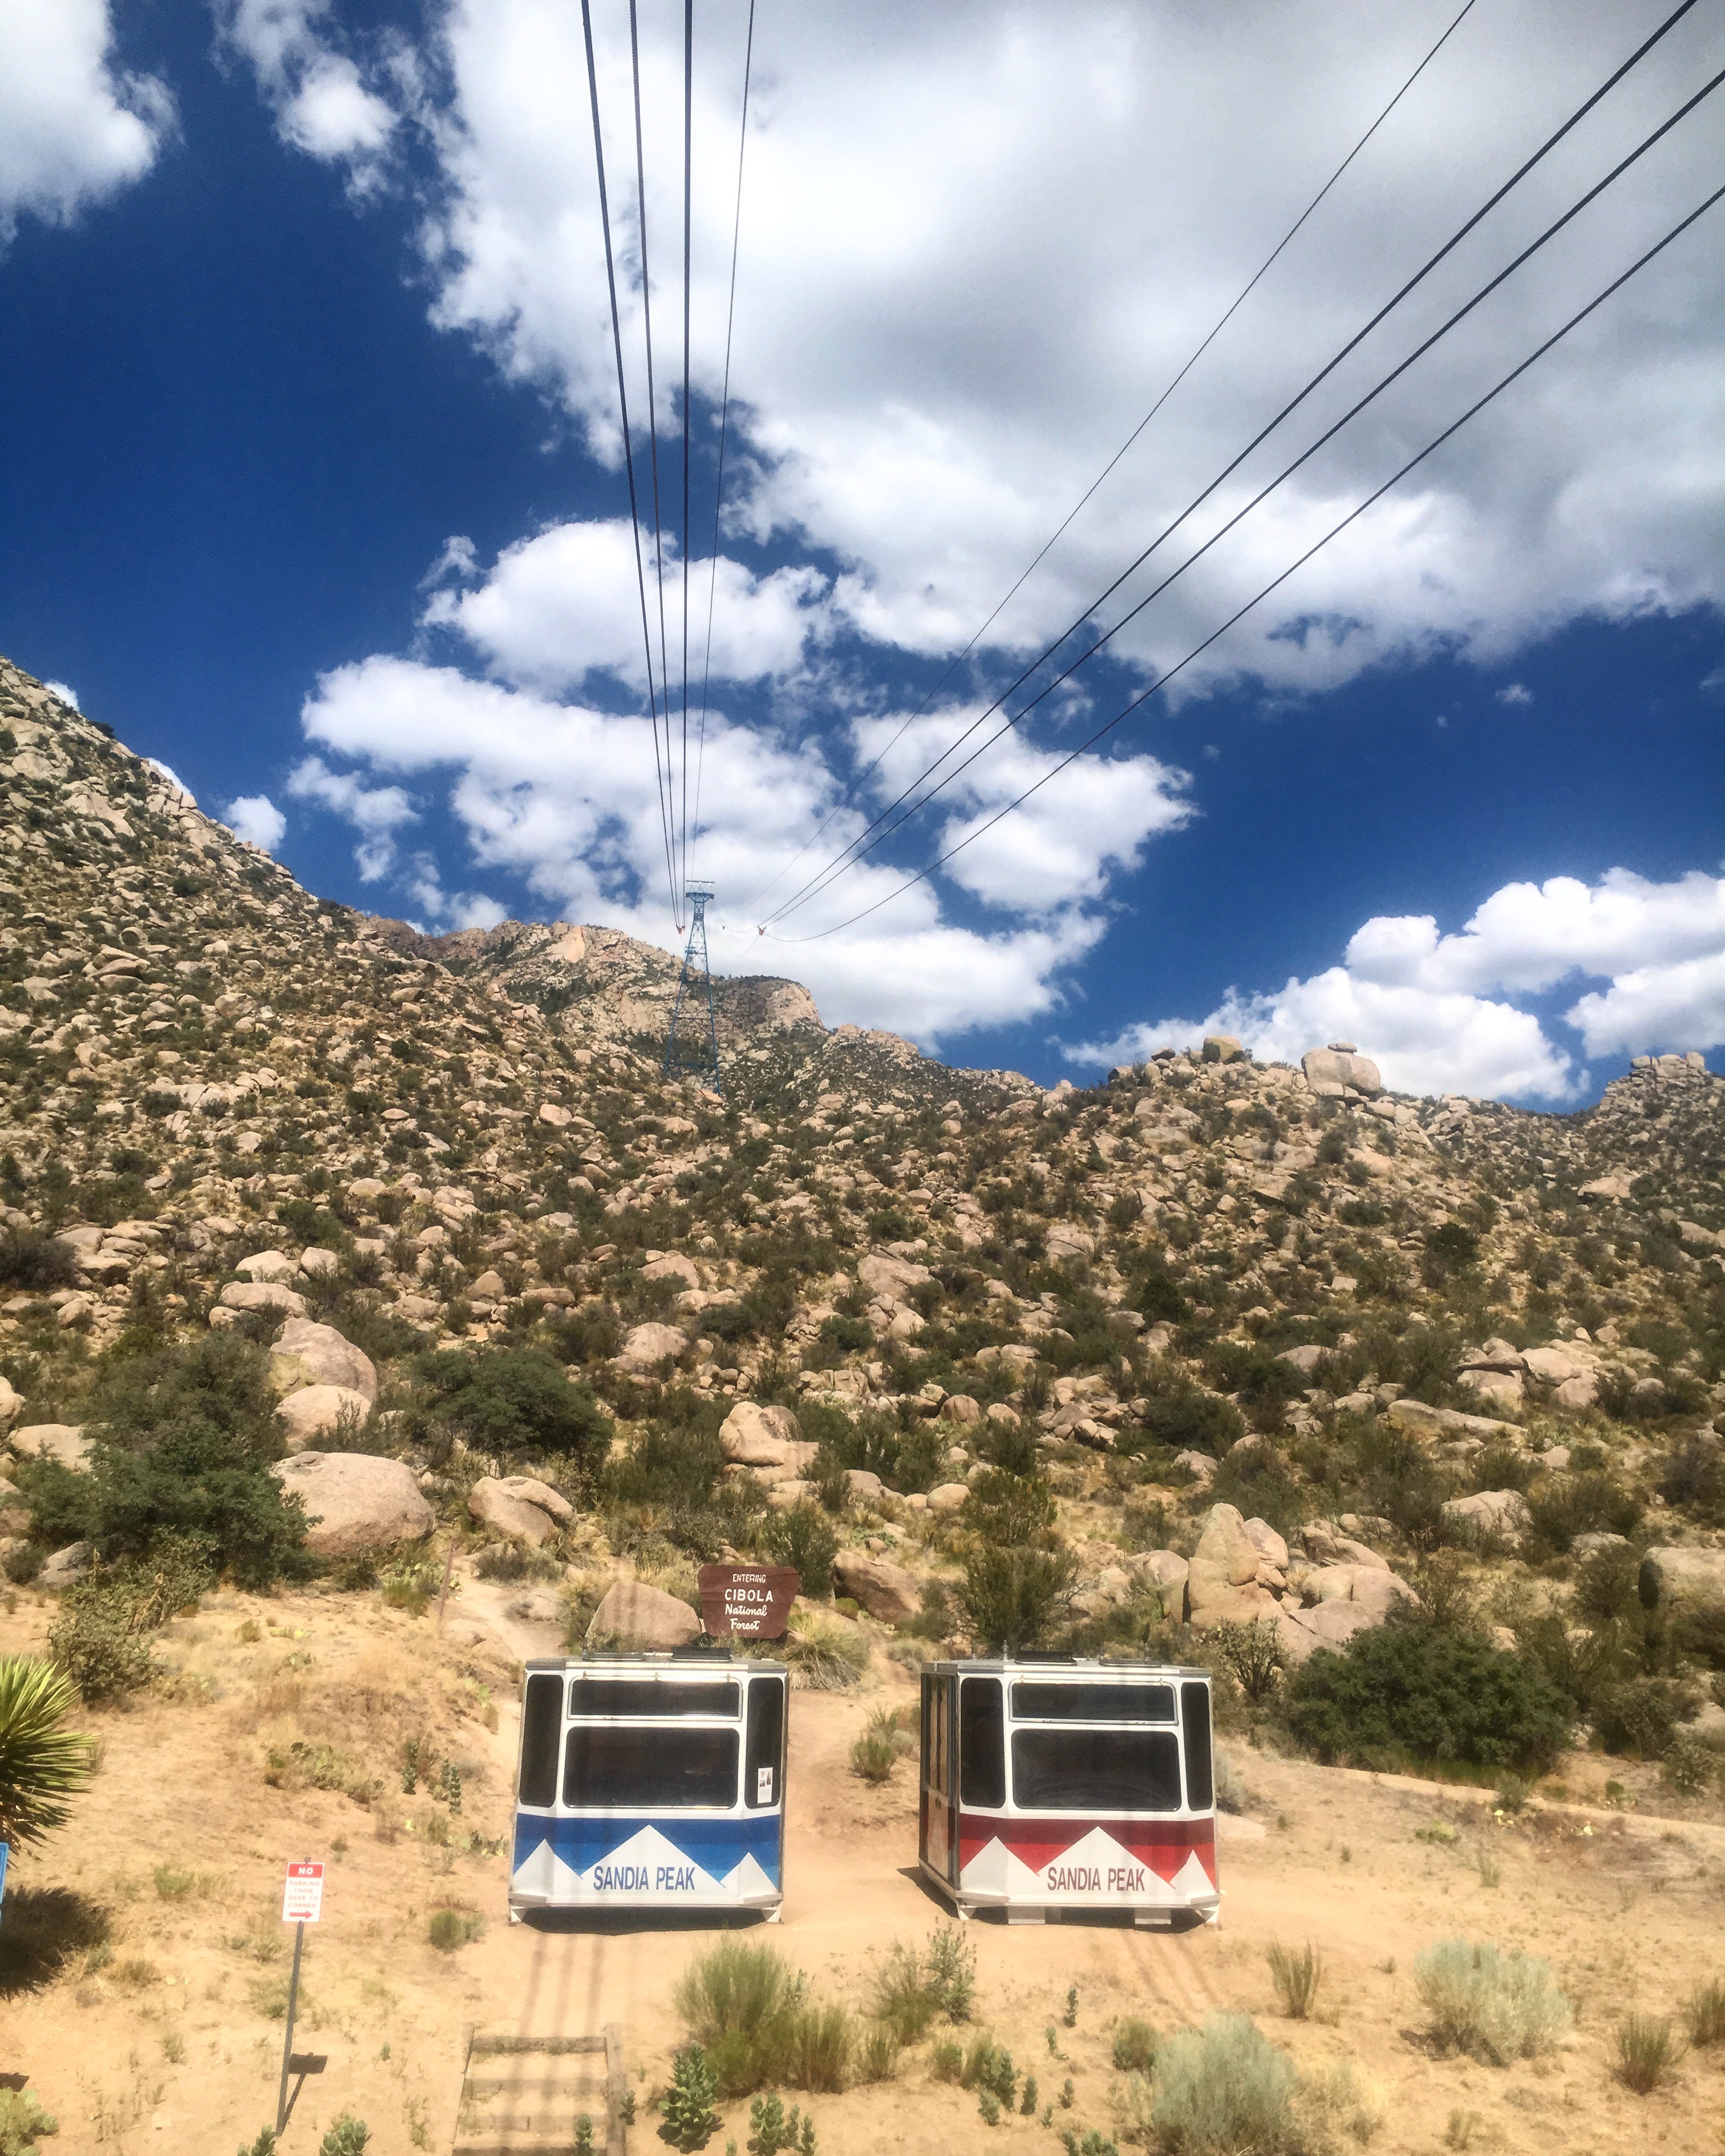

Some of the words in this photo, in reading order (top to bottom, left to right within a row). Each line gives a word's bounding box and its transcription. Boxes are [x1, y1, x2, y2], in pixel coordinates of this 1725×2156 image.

[732, 1573, 766, 1583] ENTERING
[724, 1588, 774, 1602] CIBOLA
[724, 1603, 767, 1616] National
[730, 1618, 760, 1630] Forest
[593, 1865, 649, 1890] SANDIA
[656, 1867, 695, 1890] PEAK
[1047, 1867, 1101, 1891] SANDIA
[1108, 1868, 1145, 1891] PEAK
